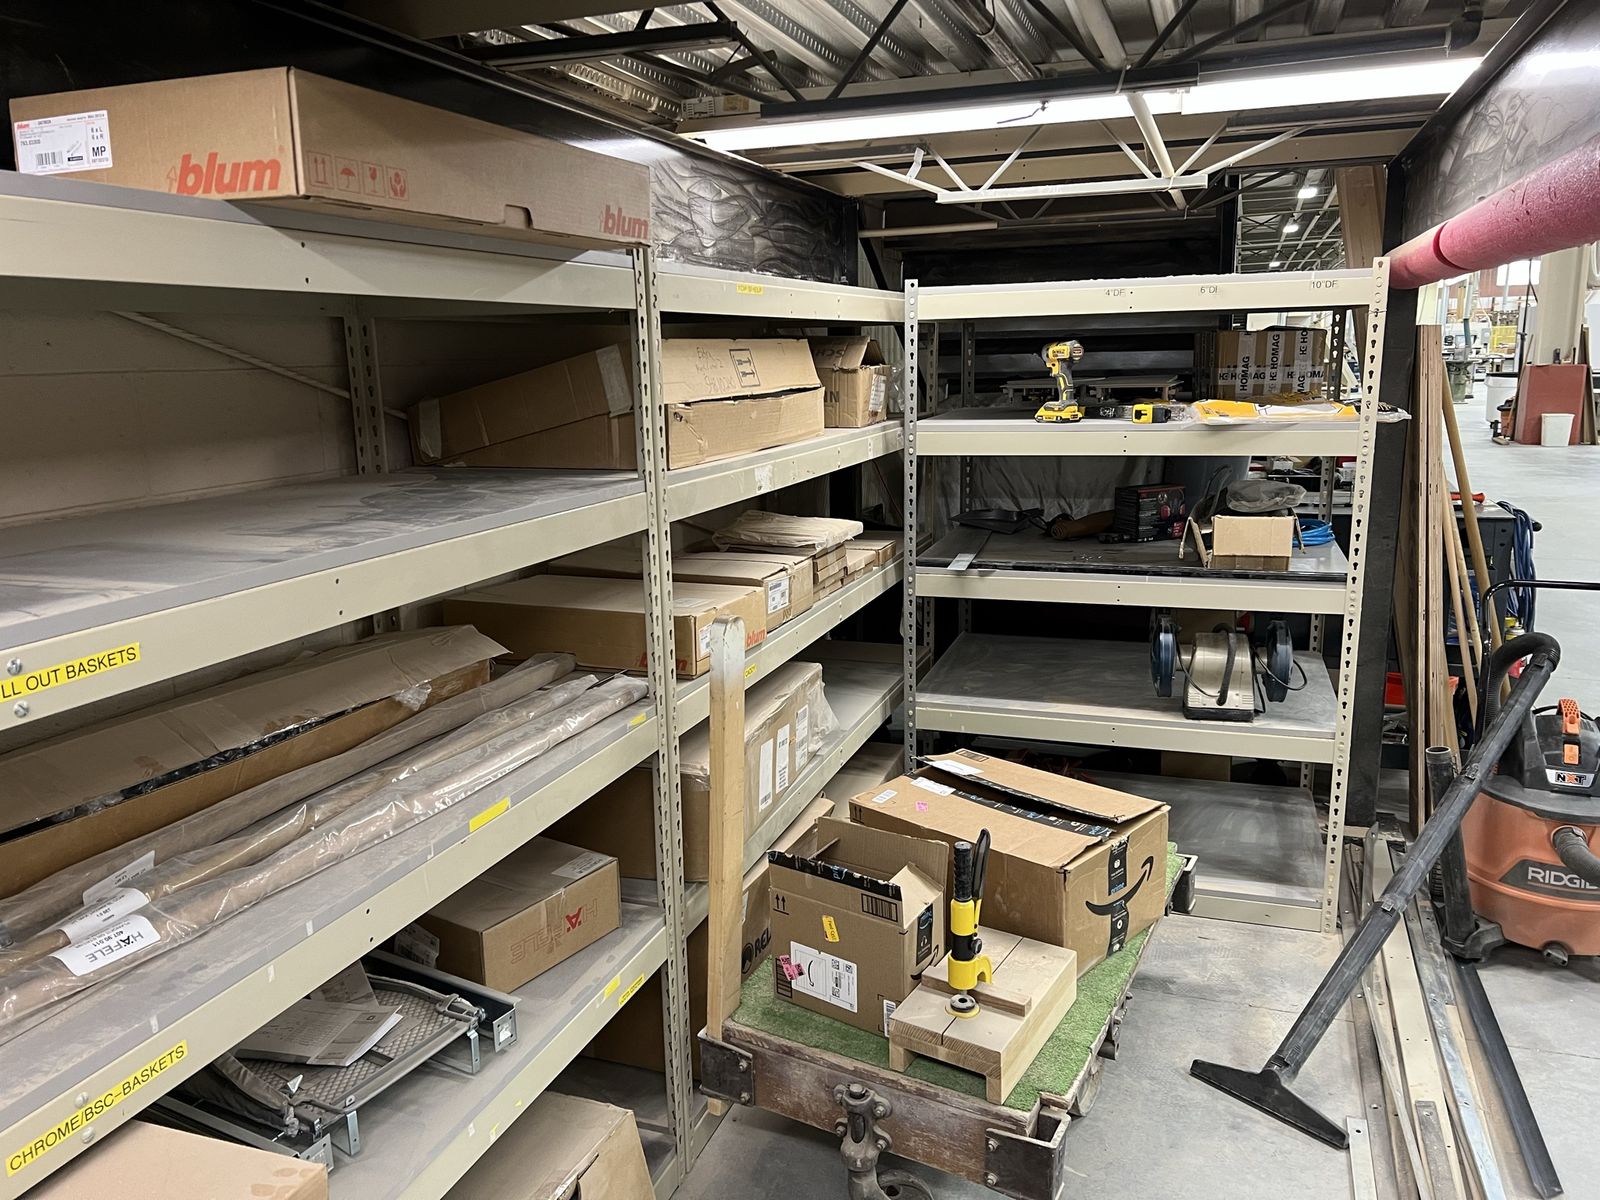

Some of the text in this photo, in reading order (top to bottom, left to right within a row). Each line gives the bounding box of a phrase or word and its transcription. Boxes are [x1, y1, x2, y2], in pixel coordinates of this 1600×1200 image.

[92, 146, 106, 158] MP
[177, 152, 282, 196] blum
[603, 204, 648, 239] blum
[1270, 333, 1280, 370] HOMAG
[1240, 356, 1250, 391] HOMAG
[26, 668, 61, 691] OUT
[65, 647, 137, 680] BASKETS
[1555, 771, 1587, 786] NXT
[9, 1045, 186, 1172] CHROME/BSC-BASKETS
